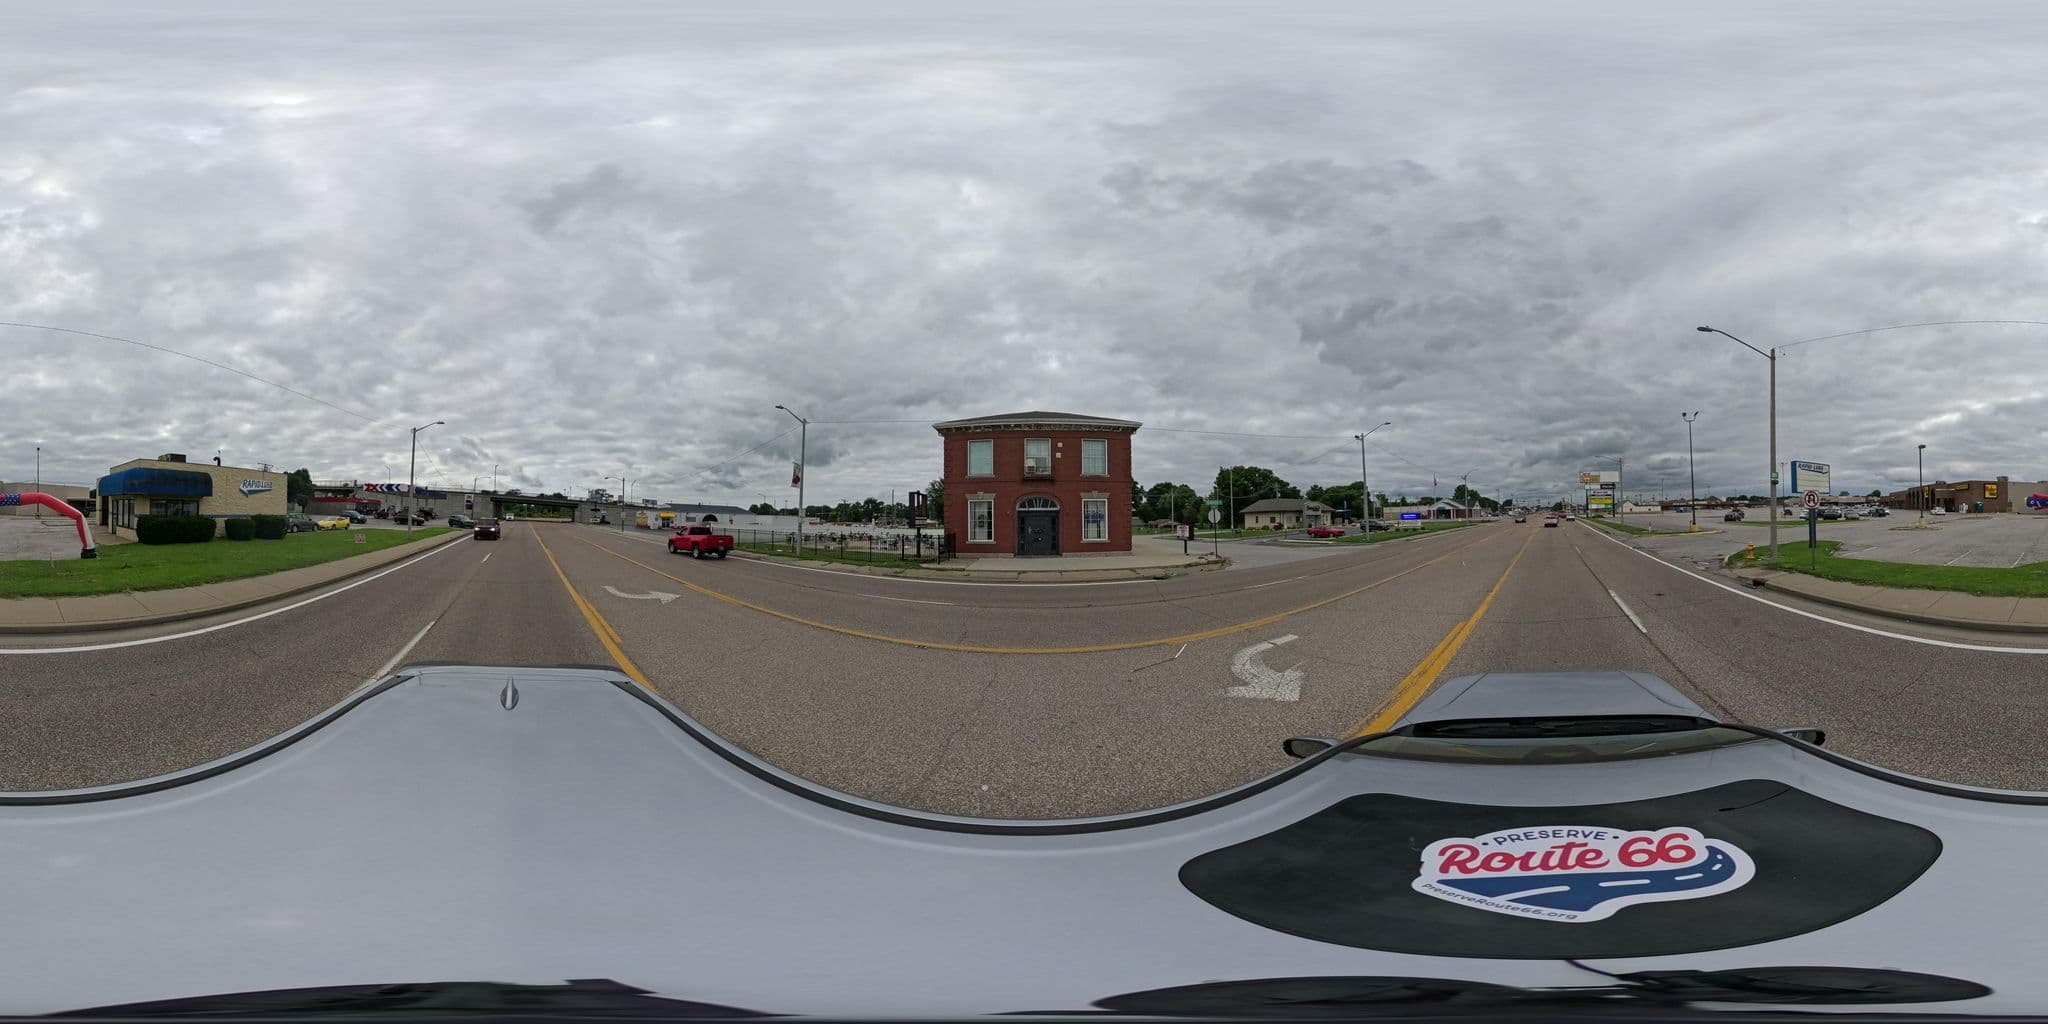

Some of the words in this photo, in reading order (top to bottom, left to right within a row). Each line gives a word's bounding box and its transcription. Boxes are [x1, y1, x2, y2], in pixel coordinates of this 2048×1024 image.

[1494, 830, 1609, 845] PRESERVE
[1437, 841, 1610, 874] Route
[1617, 833, 1697, 868] 66
